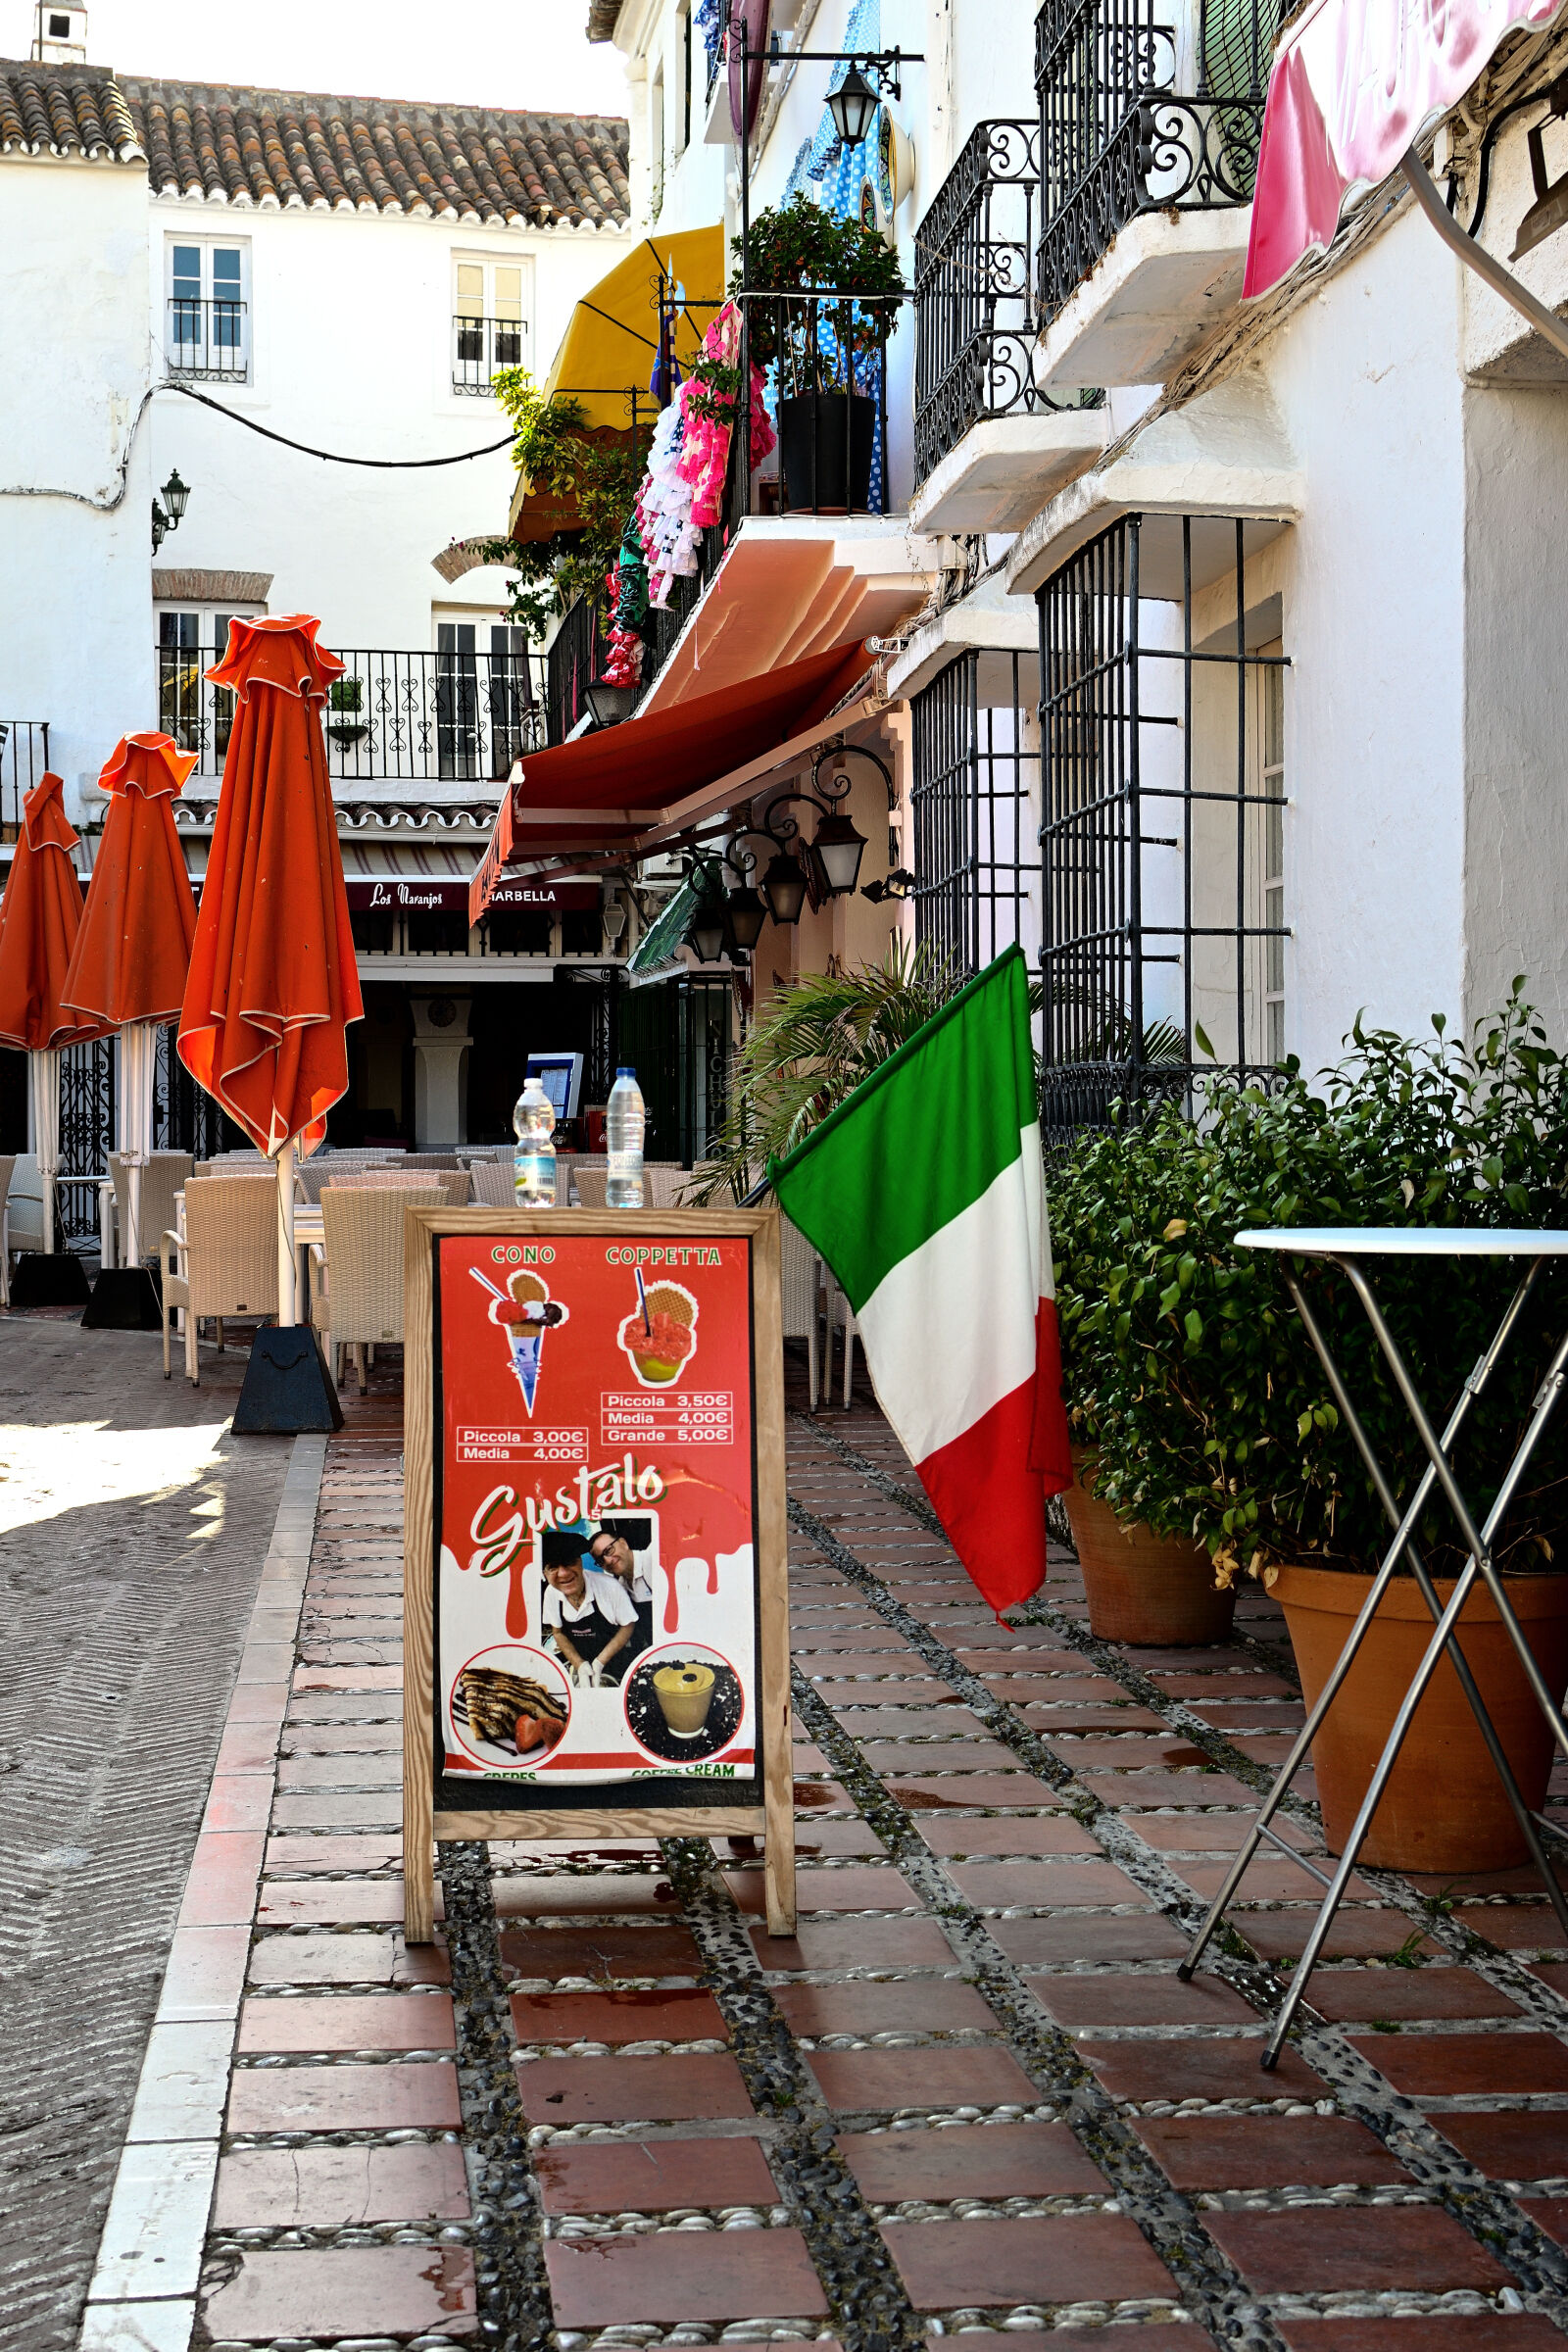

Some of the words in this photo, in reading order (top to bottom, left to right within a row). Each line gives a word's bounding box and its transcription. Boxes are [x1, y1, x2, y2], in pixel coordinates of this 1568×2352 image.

[369, 883, 392, 907] Los
[397, 883, 443, 909] Naranjos
[491, 890, 556, 902] ARBELLA
[491, 1246, 556, 1264] CONO
[606, 1247, 721, 1265] COPPETTA
[608, 1396, 665, 1407] Piccola
[677, 1395, 728, 1408] 3,50€
[608, 1412, 655, 1424] Media
[678, 1412, 728, 1425] 4,00€
[464, 1431, 521, 1443] Piccola
[532, 1431, 584, 1445] 3,00€
[608, 1430, 665, 1442] Grande
[677, 1429, 728, 1443] 5,00€
[464, 1447, 510, 1459] Media
[533, 1447, 584, 1460] 4,00€
[470, 1452, 665, 1577] Gustalo
